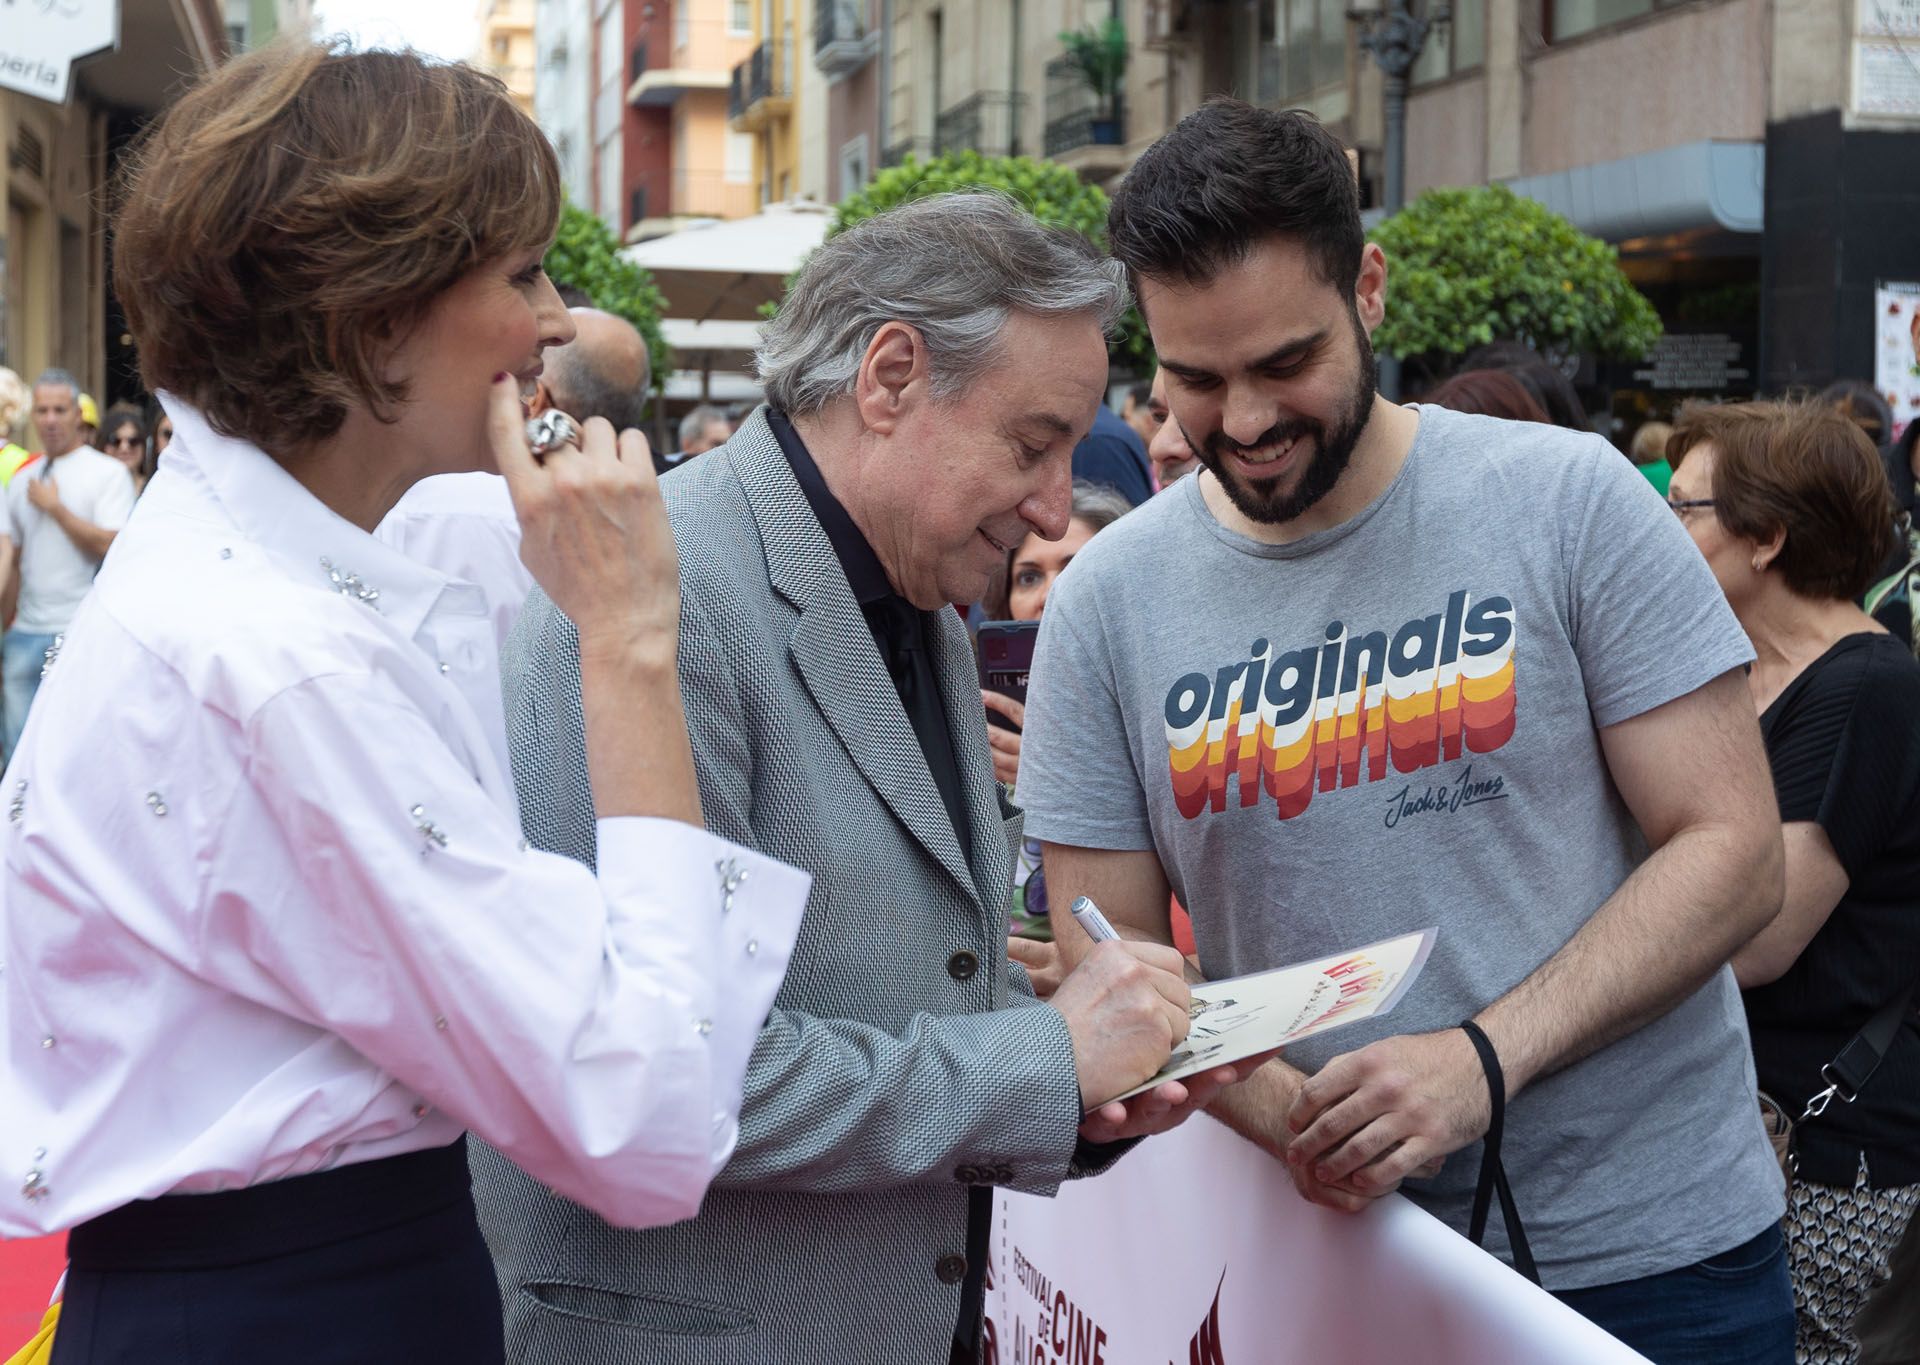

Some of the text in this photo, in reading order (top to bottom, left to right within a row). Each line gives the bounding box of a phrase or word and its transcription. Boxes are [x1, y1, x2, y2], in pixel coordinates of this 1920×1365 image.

[1164, 589, 1515, 748] originals
[1013, 1245, 1051, 1312] FESTIVAL
[1038, 1311, 1049, 1345] DE
[1052, 1290, 1107, 1365] CINE
